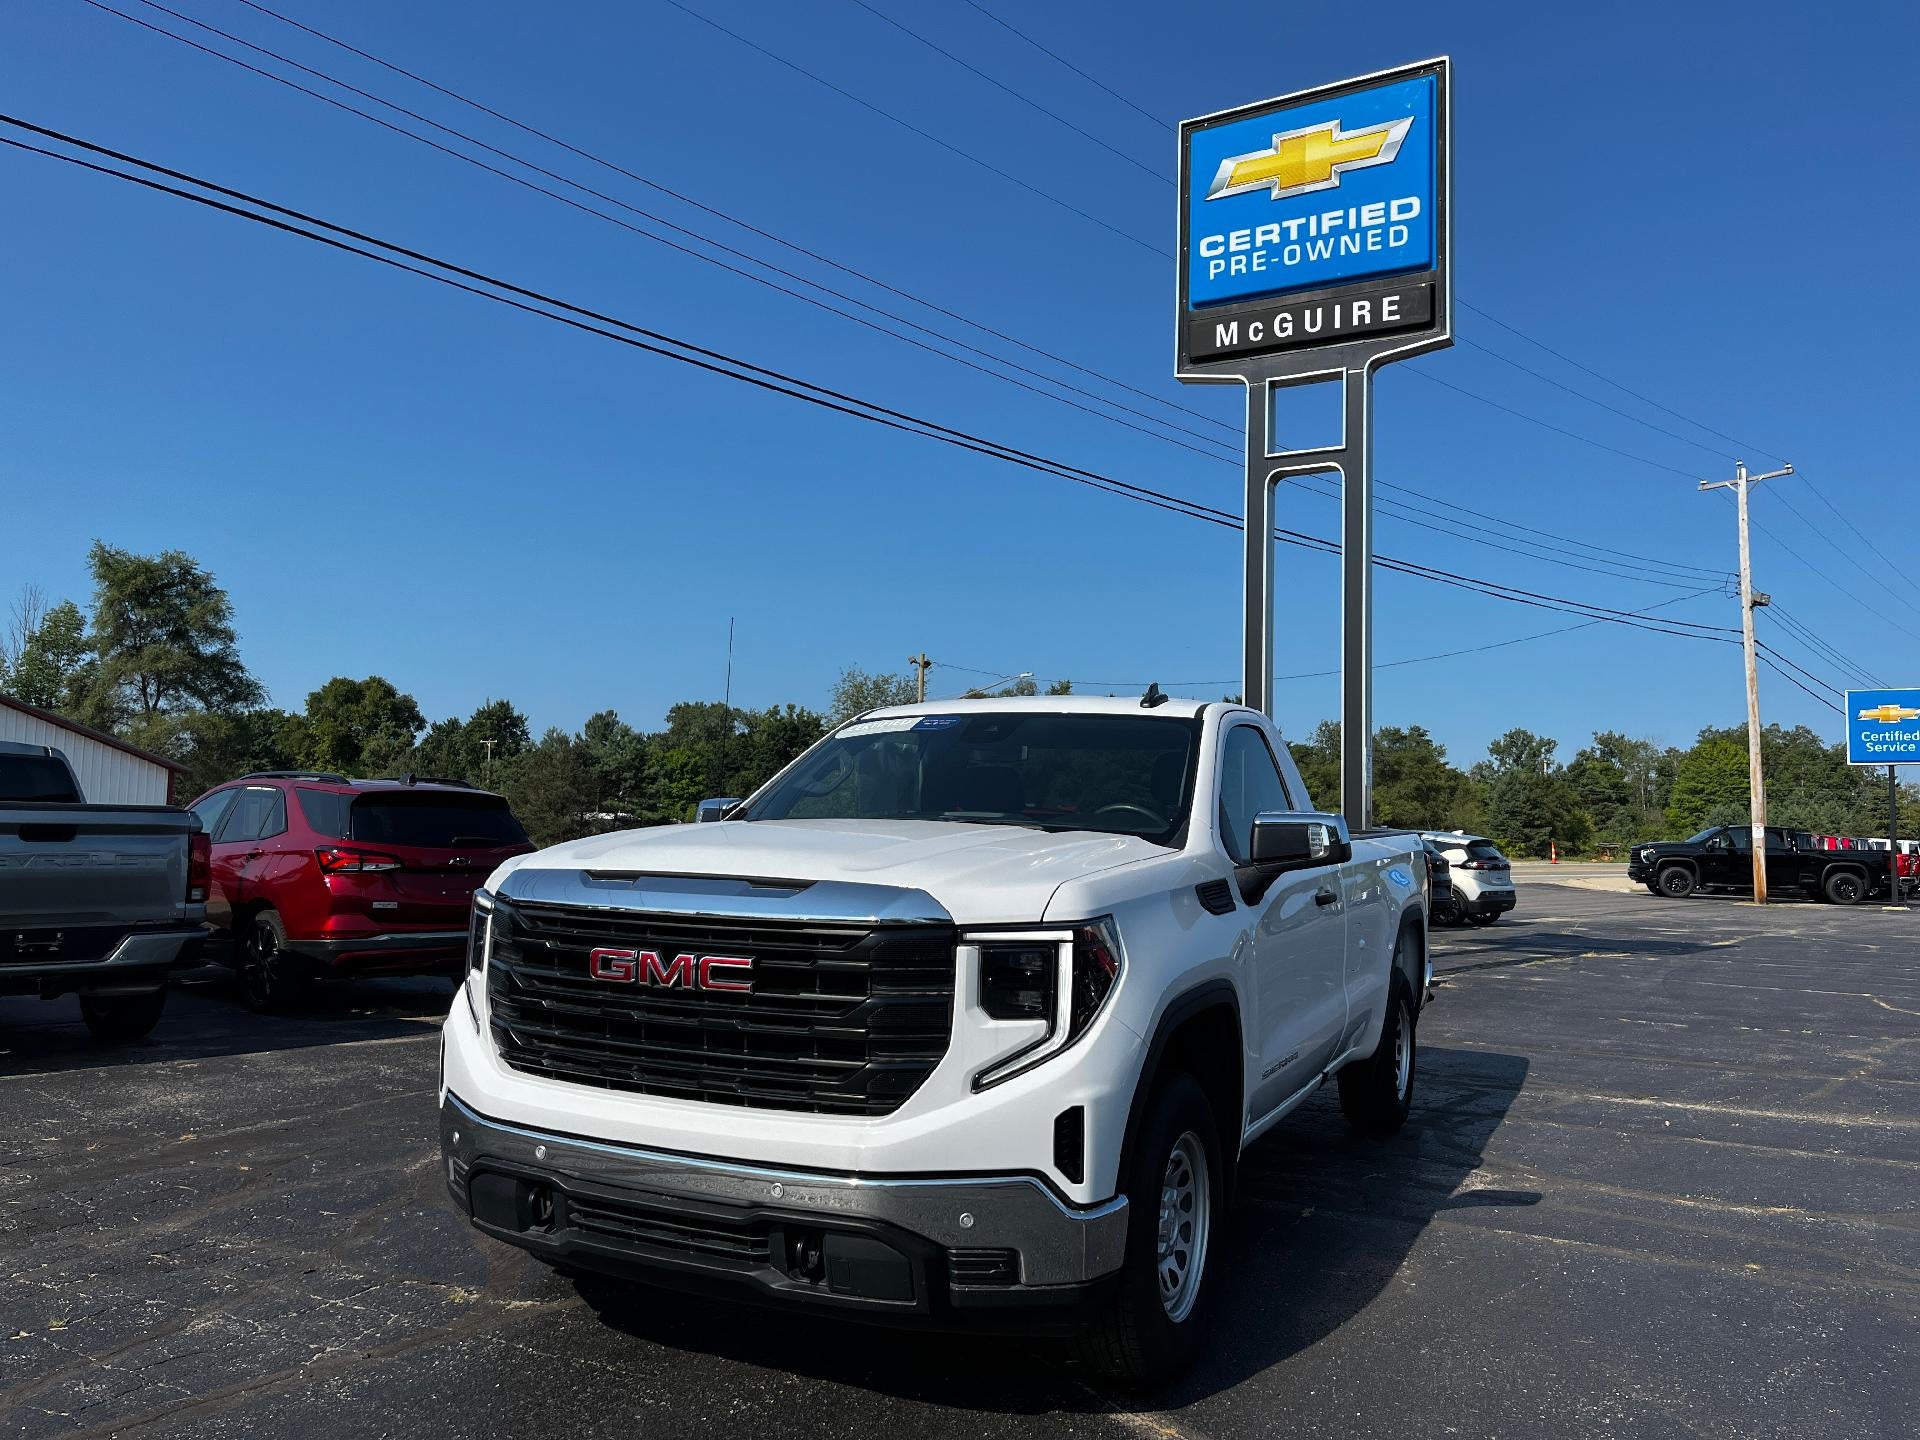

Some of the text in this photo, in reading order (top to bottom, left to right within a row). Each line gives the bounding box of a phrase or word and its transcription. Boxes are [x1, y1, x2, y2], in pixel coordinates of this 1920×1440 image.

[1199, 196, 1421, 258] CERTIFIED
[1208, 224, 1409, 281] PRE-OWNED
[1216, 295, 1401, 348] McGUIRE
[1861, 731, 1920, 742] Certified
[1866, 742, 1916, 752] Service
[590, 947, 755, 993] GMC
